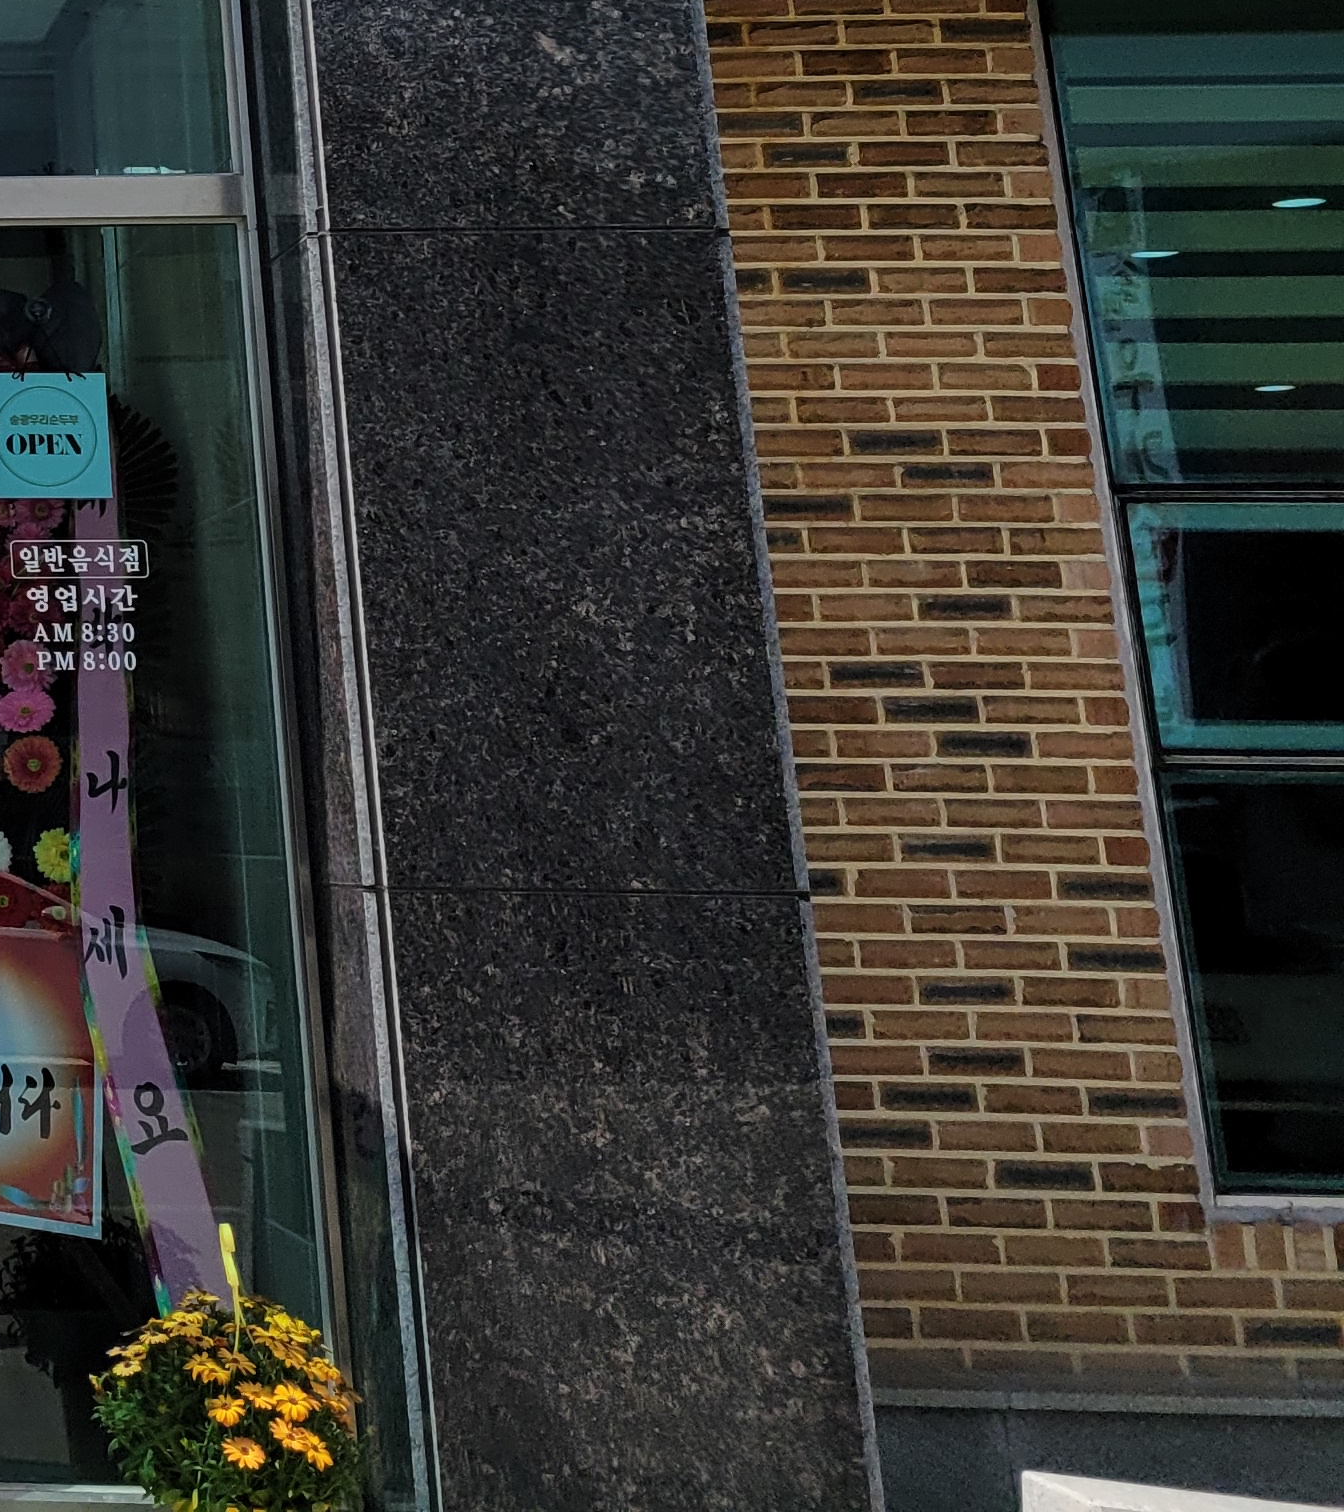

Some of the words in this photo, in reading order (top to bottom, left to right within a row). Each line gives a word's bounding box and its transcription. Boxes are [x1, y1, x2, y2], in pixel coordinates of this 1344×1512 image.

[5, 432, 83, 456] OPEN
[18, 543, 141, 574] 일반음식점
[25, 584, 139, 613] 영업시간
[32, 622, 74, 643] AM
[80, 622, 136, 643] 8:30
[36, 651, 76, 671] PM
[82, 650, 138, 672] 8:00
